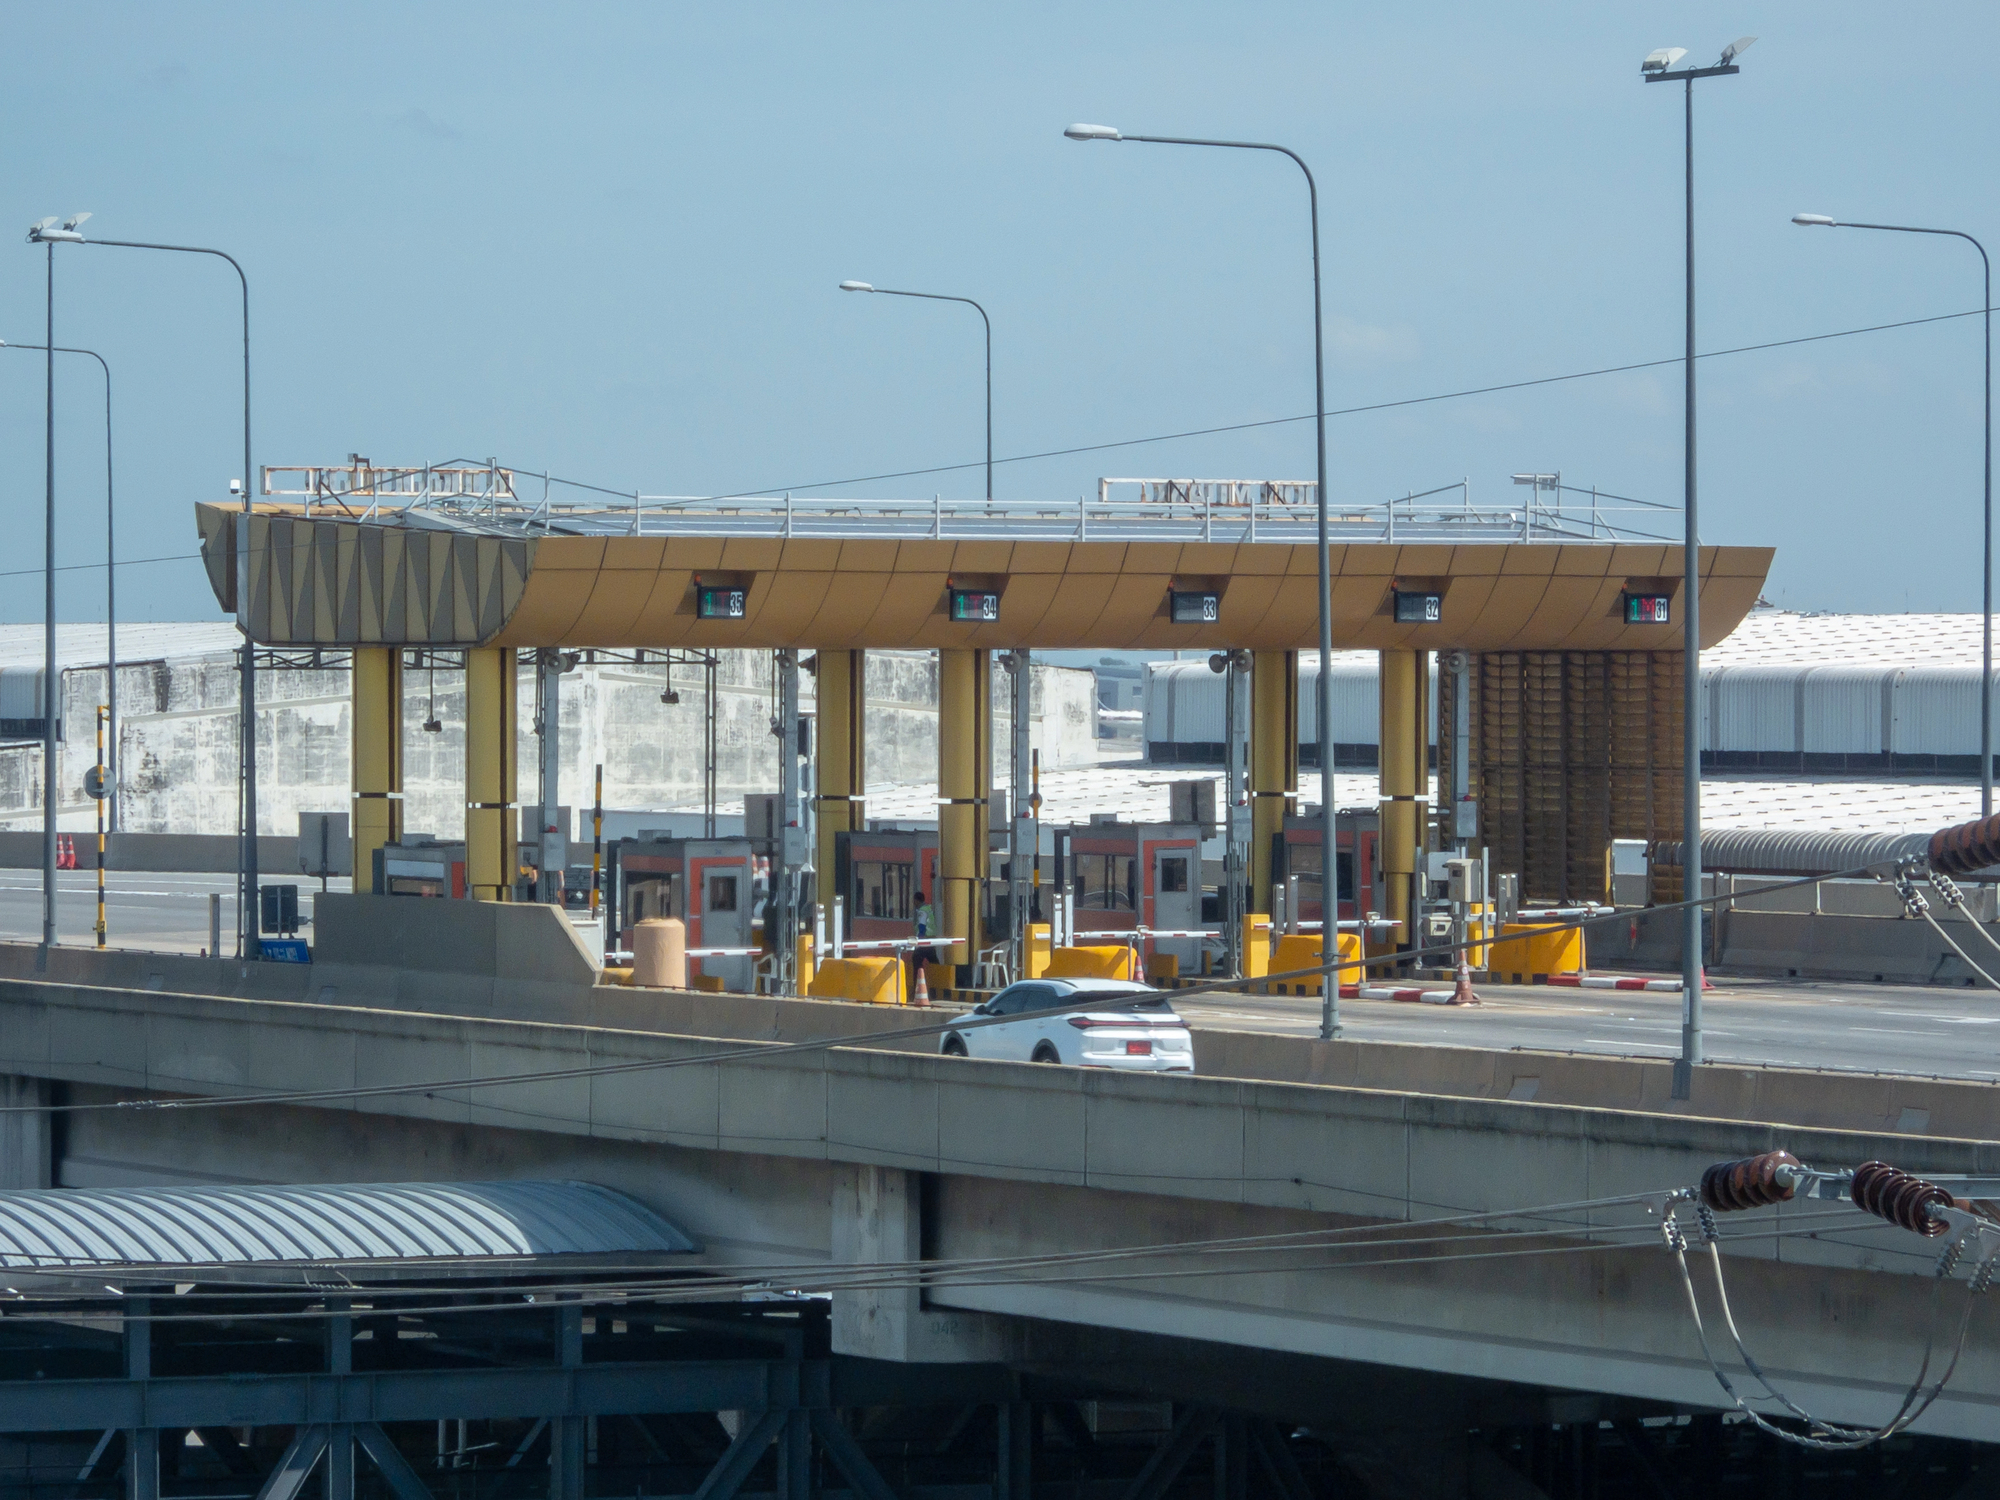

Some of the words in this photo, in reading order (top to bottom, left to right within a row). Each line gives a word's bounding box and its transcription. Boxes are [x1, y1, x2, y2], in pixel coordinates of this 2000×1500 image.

[730, 594, 742, 614] 35
[983, 597, 996, 617] 34
[1204, 599, 1216, 618] 33
[1426, 599, 1438, 618] 32
[1656, 600, 1667, 619] 31
